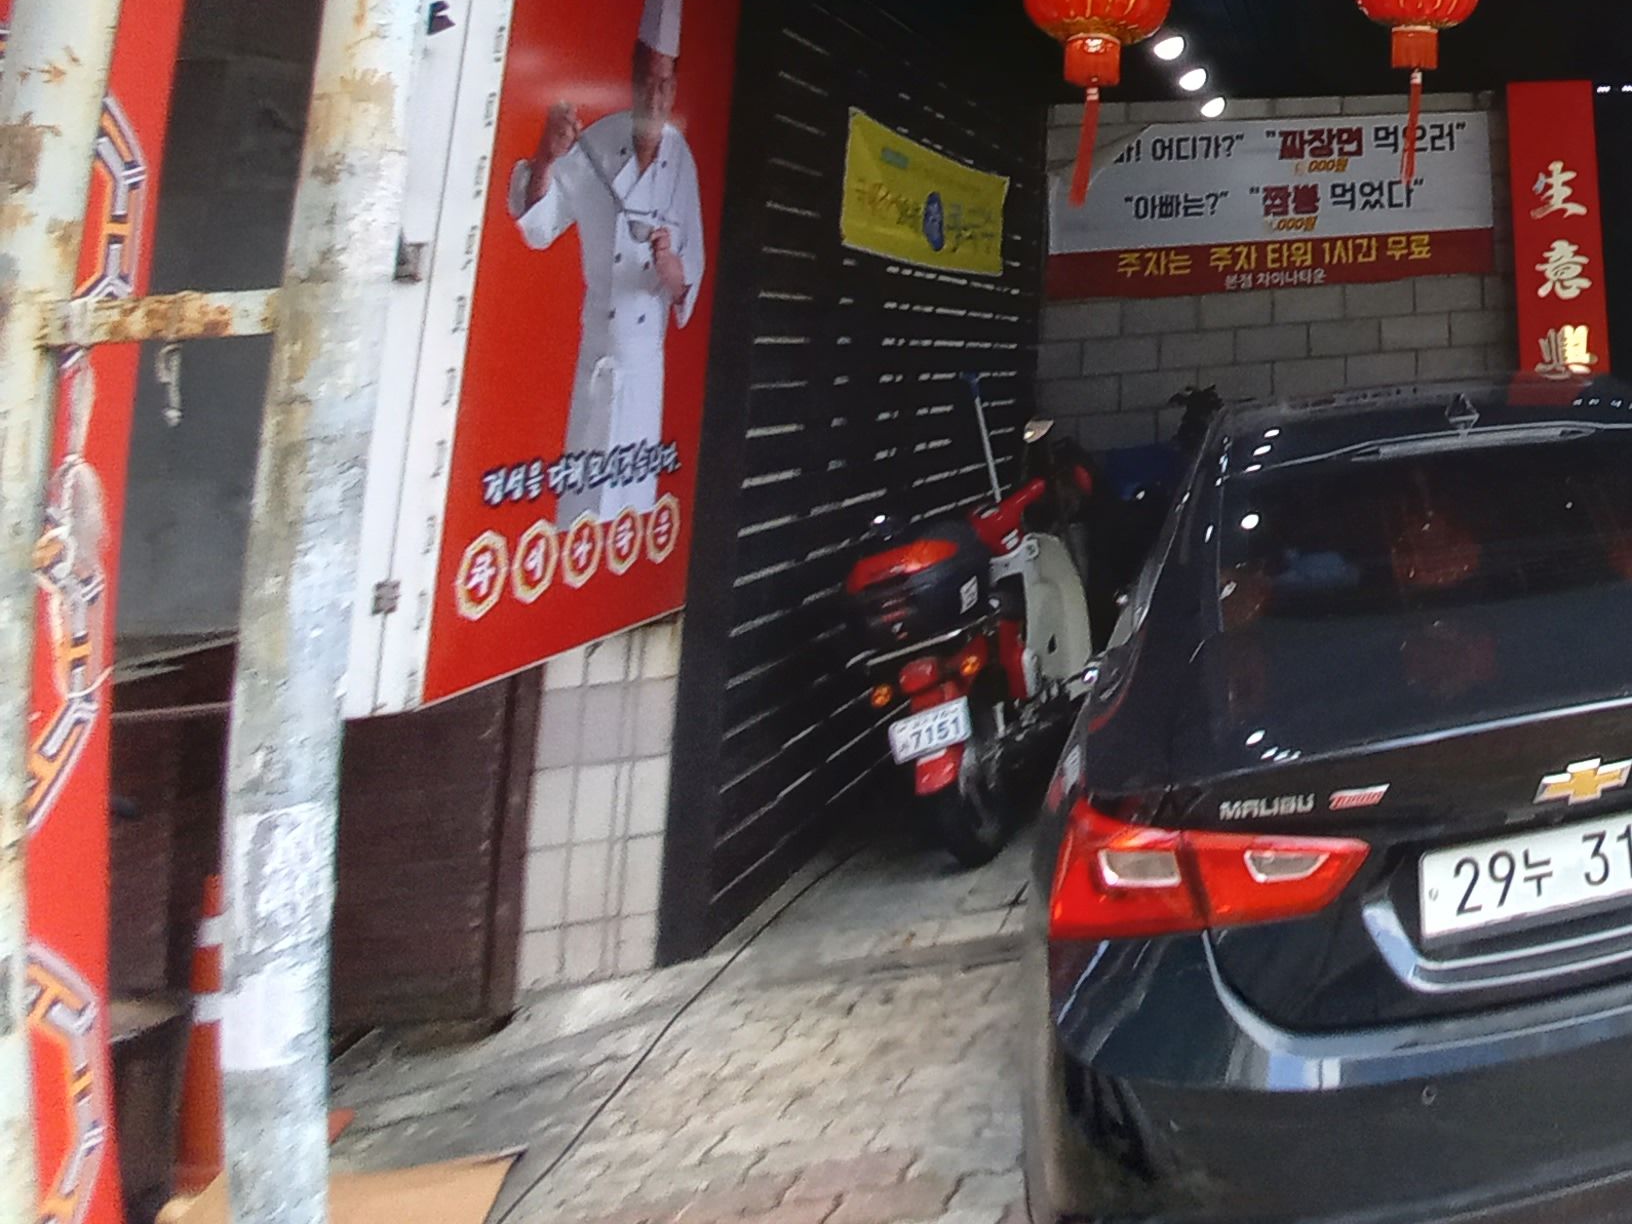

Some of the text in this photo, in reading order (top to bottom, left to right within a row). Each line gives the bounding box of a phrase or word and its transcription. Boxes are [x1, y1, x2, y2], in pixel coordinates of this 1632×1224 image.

[1116, 233, 1432, 278] 주차는 주차 타워 1시간 무료
[1218, 792, 1316, 822] MALIBU
[1452, 848, 1553, 917] 29누
